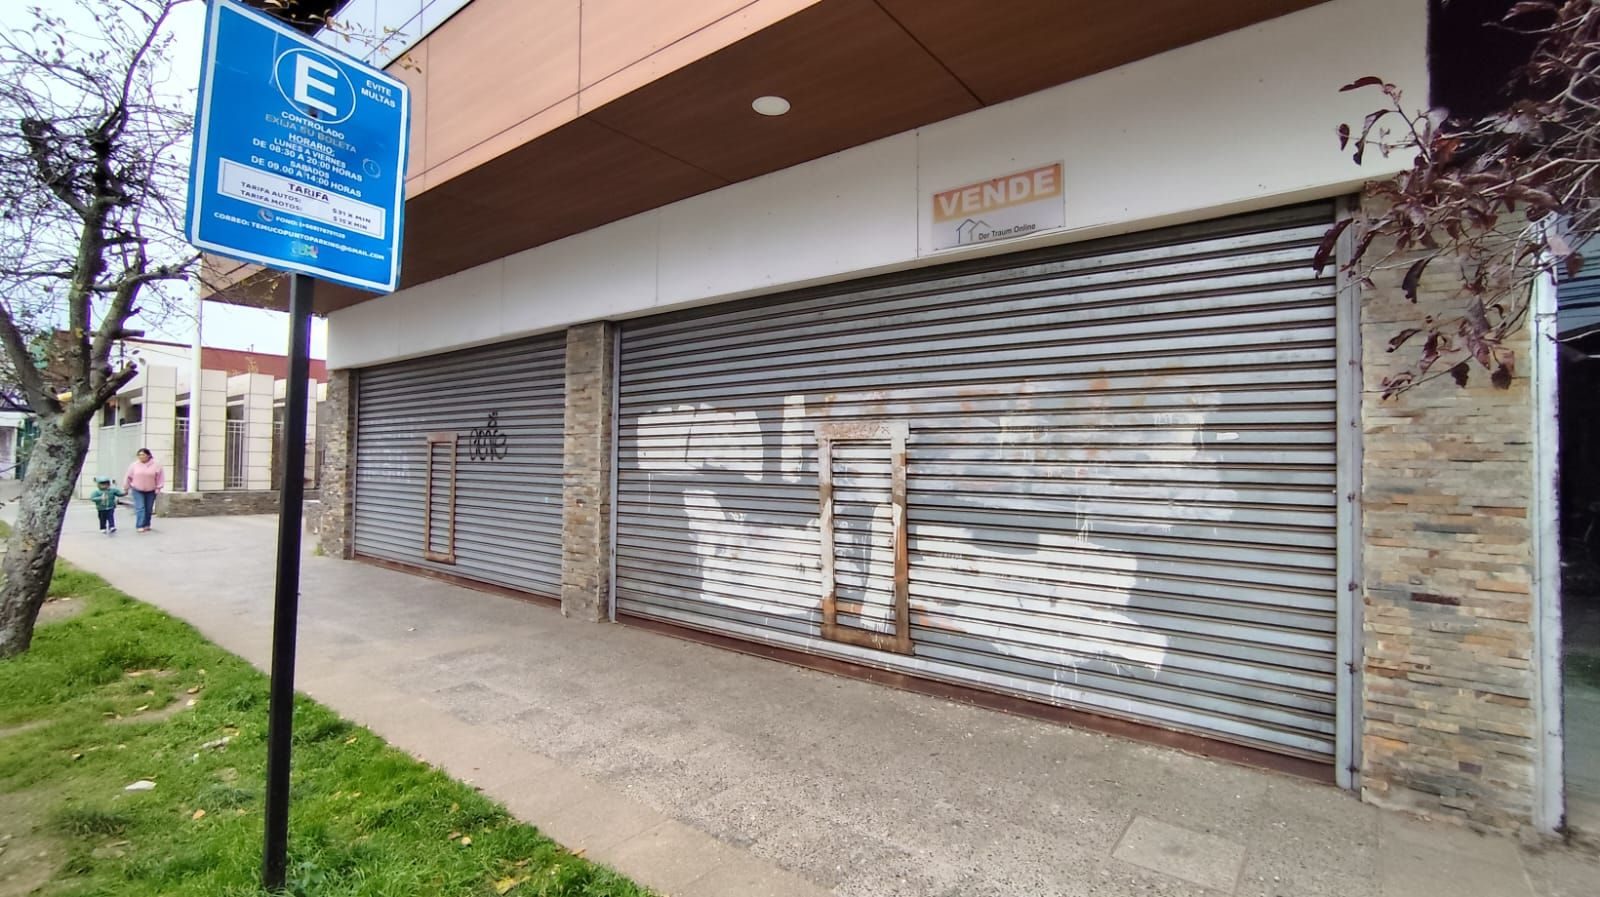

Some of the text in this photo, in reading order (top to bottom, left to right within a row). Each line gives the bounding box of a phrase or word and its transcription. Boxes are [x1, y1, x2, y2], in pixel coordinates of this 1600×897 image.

[294, 53, 339, 117] E
[366, 79, 392, 97] EVITE
[361, 87, 396, 109] MULTAS
[265, 113, 357, 153] EXIJA SU BOLETA
[281, 111, 345, 140] CONTROLADO
[252, 138, 363, 182] DE 08:30 A 20:00 HORAS
[274, 138, 347, 169] LUNES A VIERNES
[251, 155, 265, 166] DE
[296, 170, 303, 178] A
[306, 173, 330, 187] 14:00
[331, 181, 362, 198] HORAS
[290, 160, 330, 179] SABADOS
[240, 181, 302, 203] TARIFA AUTOS:
[240, 189, 303, 211] TARIFA MOTOS:
[288, 182, 330, 202] TARIFA
[939, 168, 1055, 216] VENDE
[213, 211, 250, 227] CORREO:
[353, 221, 368, 230] MIN
[355, 215, 371, 223] MIN
[978, 223, 1036, 240] Der Traum Online
